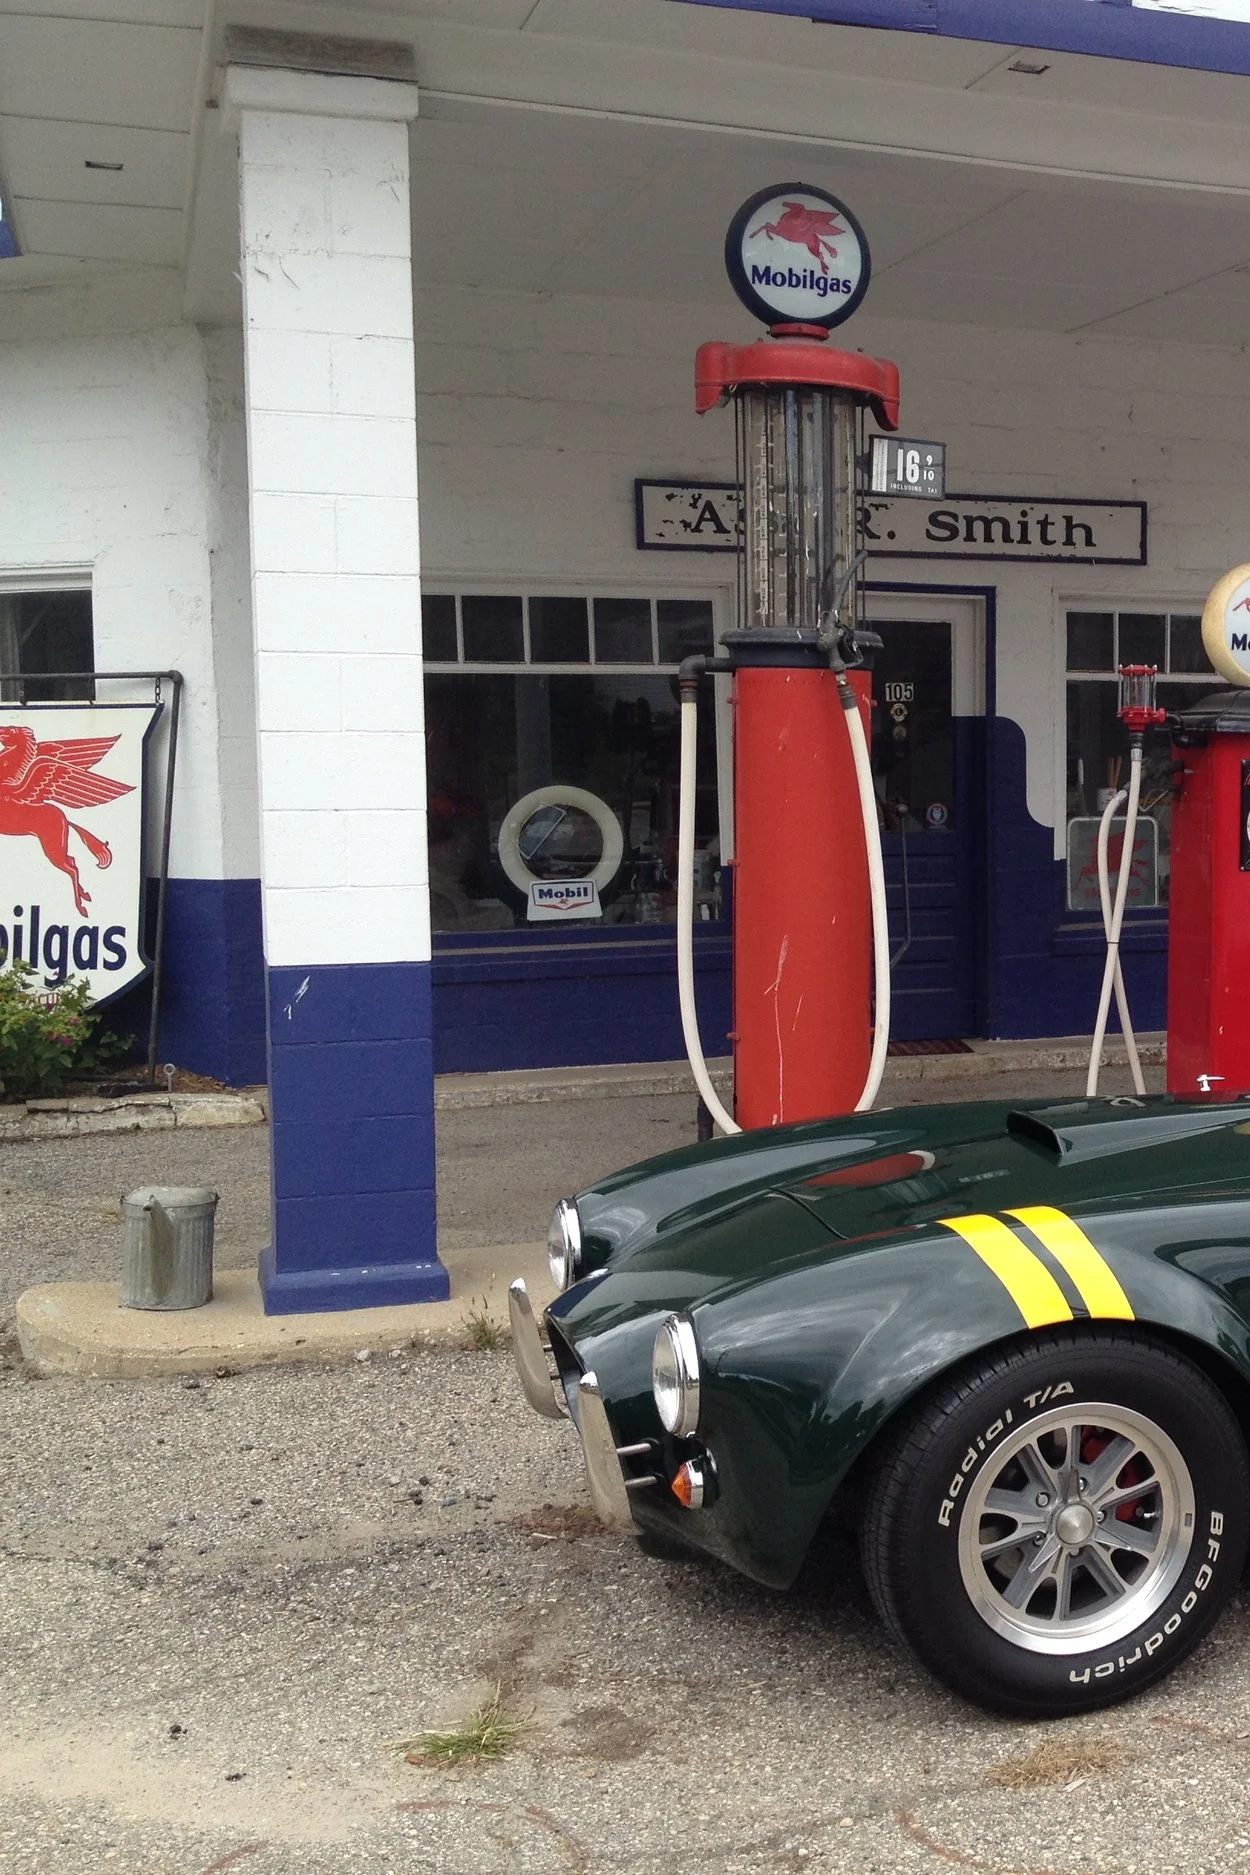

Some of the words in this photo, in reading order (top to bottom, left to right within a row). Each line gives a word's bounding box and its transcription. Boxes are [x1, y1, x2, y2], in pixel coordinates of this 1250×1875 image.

[751, 264, 852, 298] Mobilgas
[896, 448, 920, 484] 16
[923, 469, 935, 481] 10
[926, 454, 934, 466] 9
[925, 509, 1097, 548] Smith
[885, 683, 914, 702] 105
[537, 886, 589, 899] Mobil
[937, 1406, 1014, 1528] Radial
[1023, 1379, 1076, 1410] T/A
[1068, 1510, 1225, 1686] BFGoodrich
